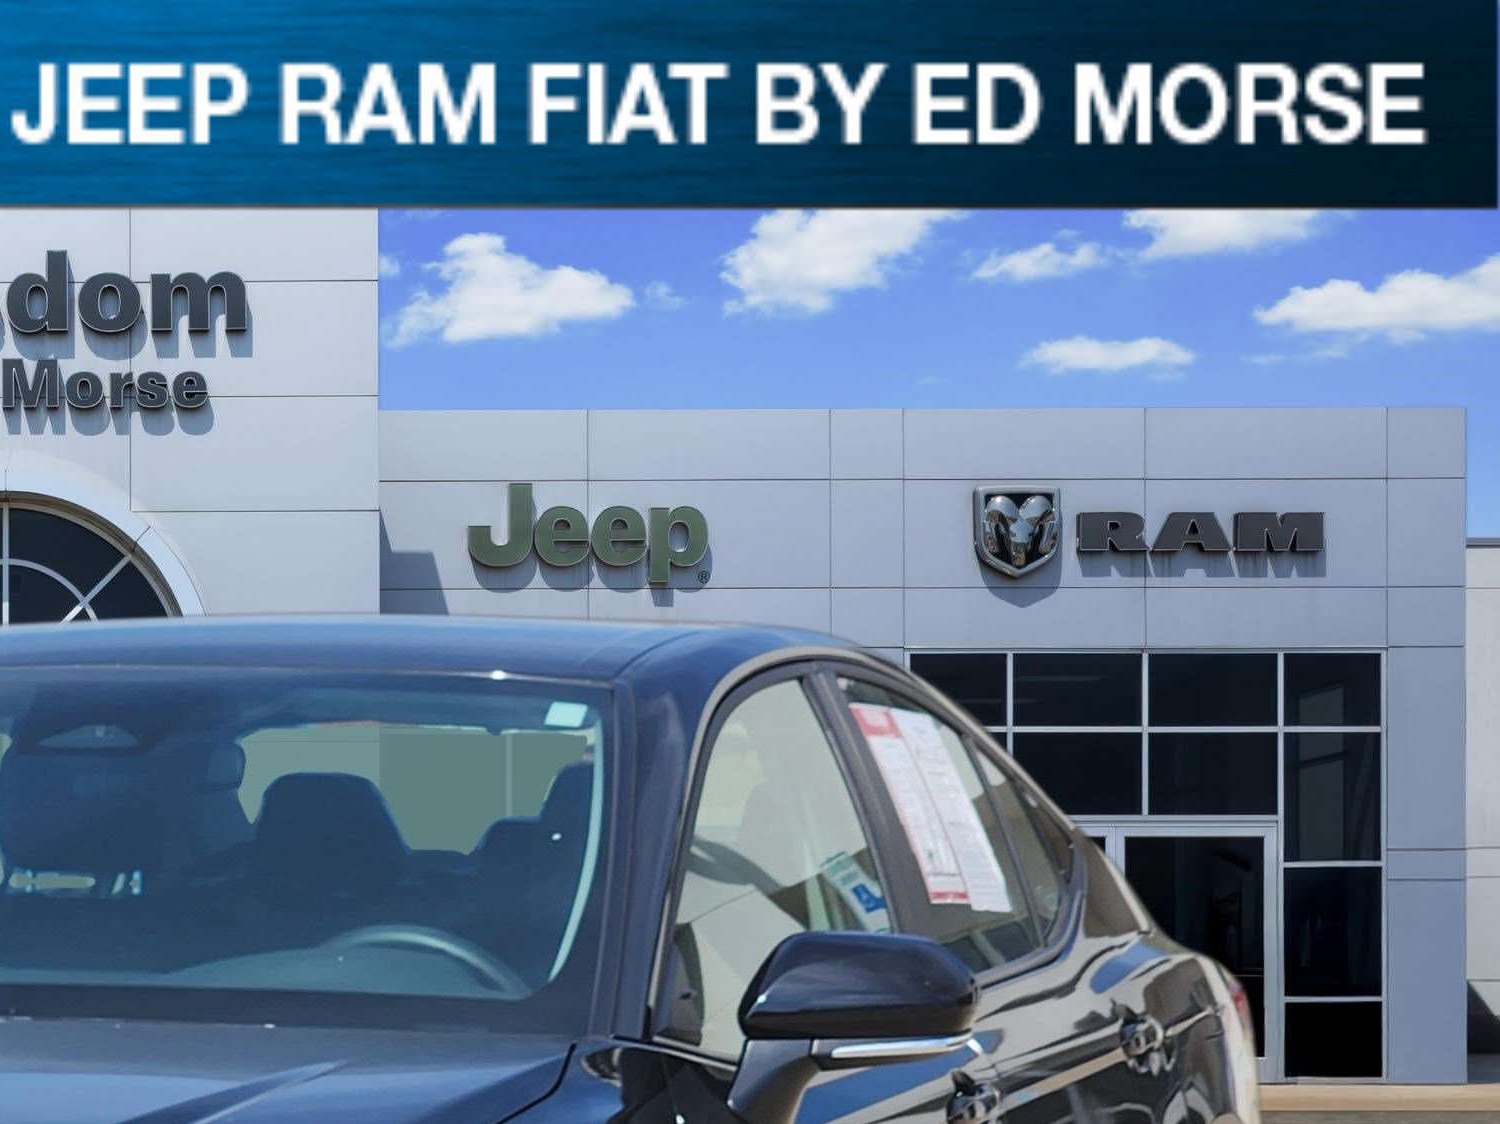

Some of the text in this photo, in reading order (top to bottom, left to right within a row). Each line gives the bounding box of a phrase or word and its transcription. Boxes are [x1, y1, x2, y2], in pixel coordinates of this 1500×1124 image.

[2, 358, 209, 408] Morse
[467, 482, 709, 584] Jeep
[1076, 511, 1326, 553] RAM
